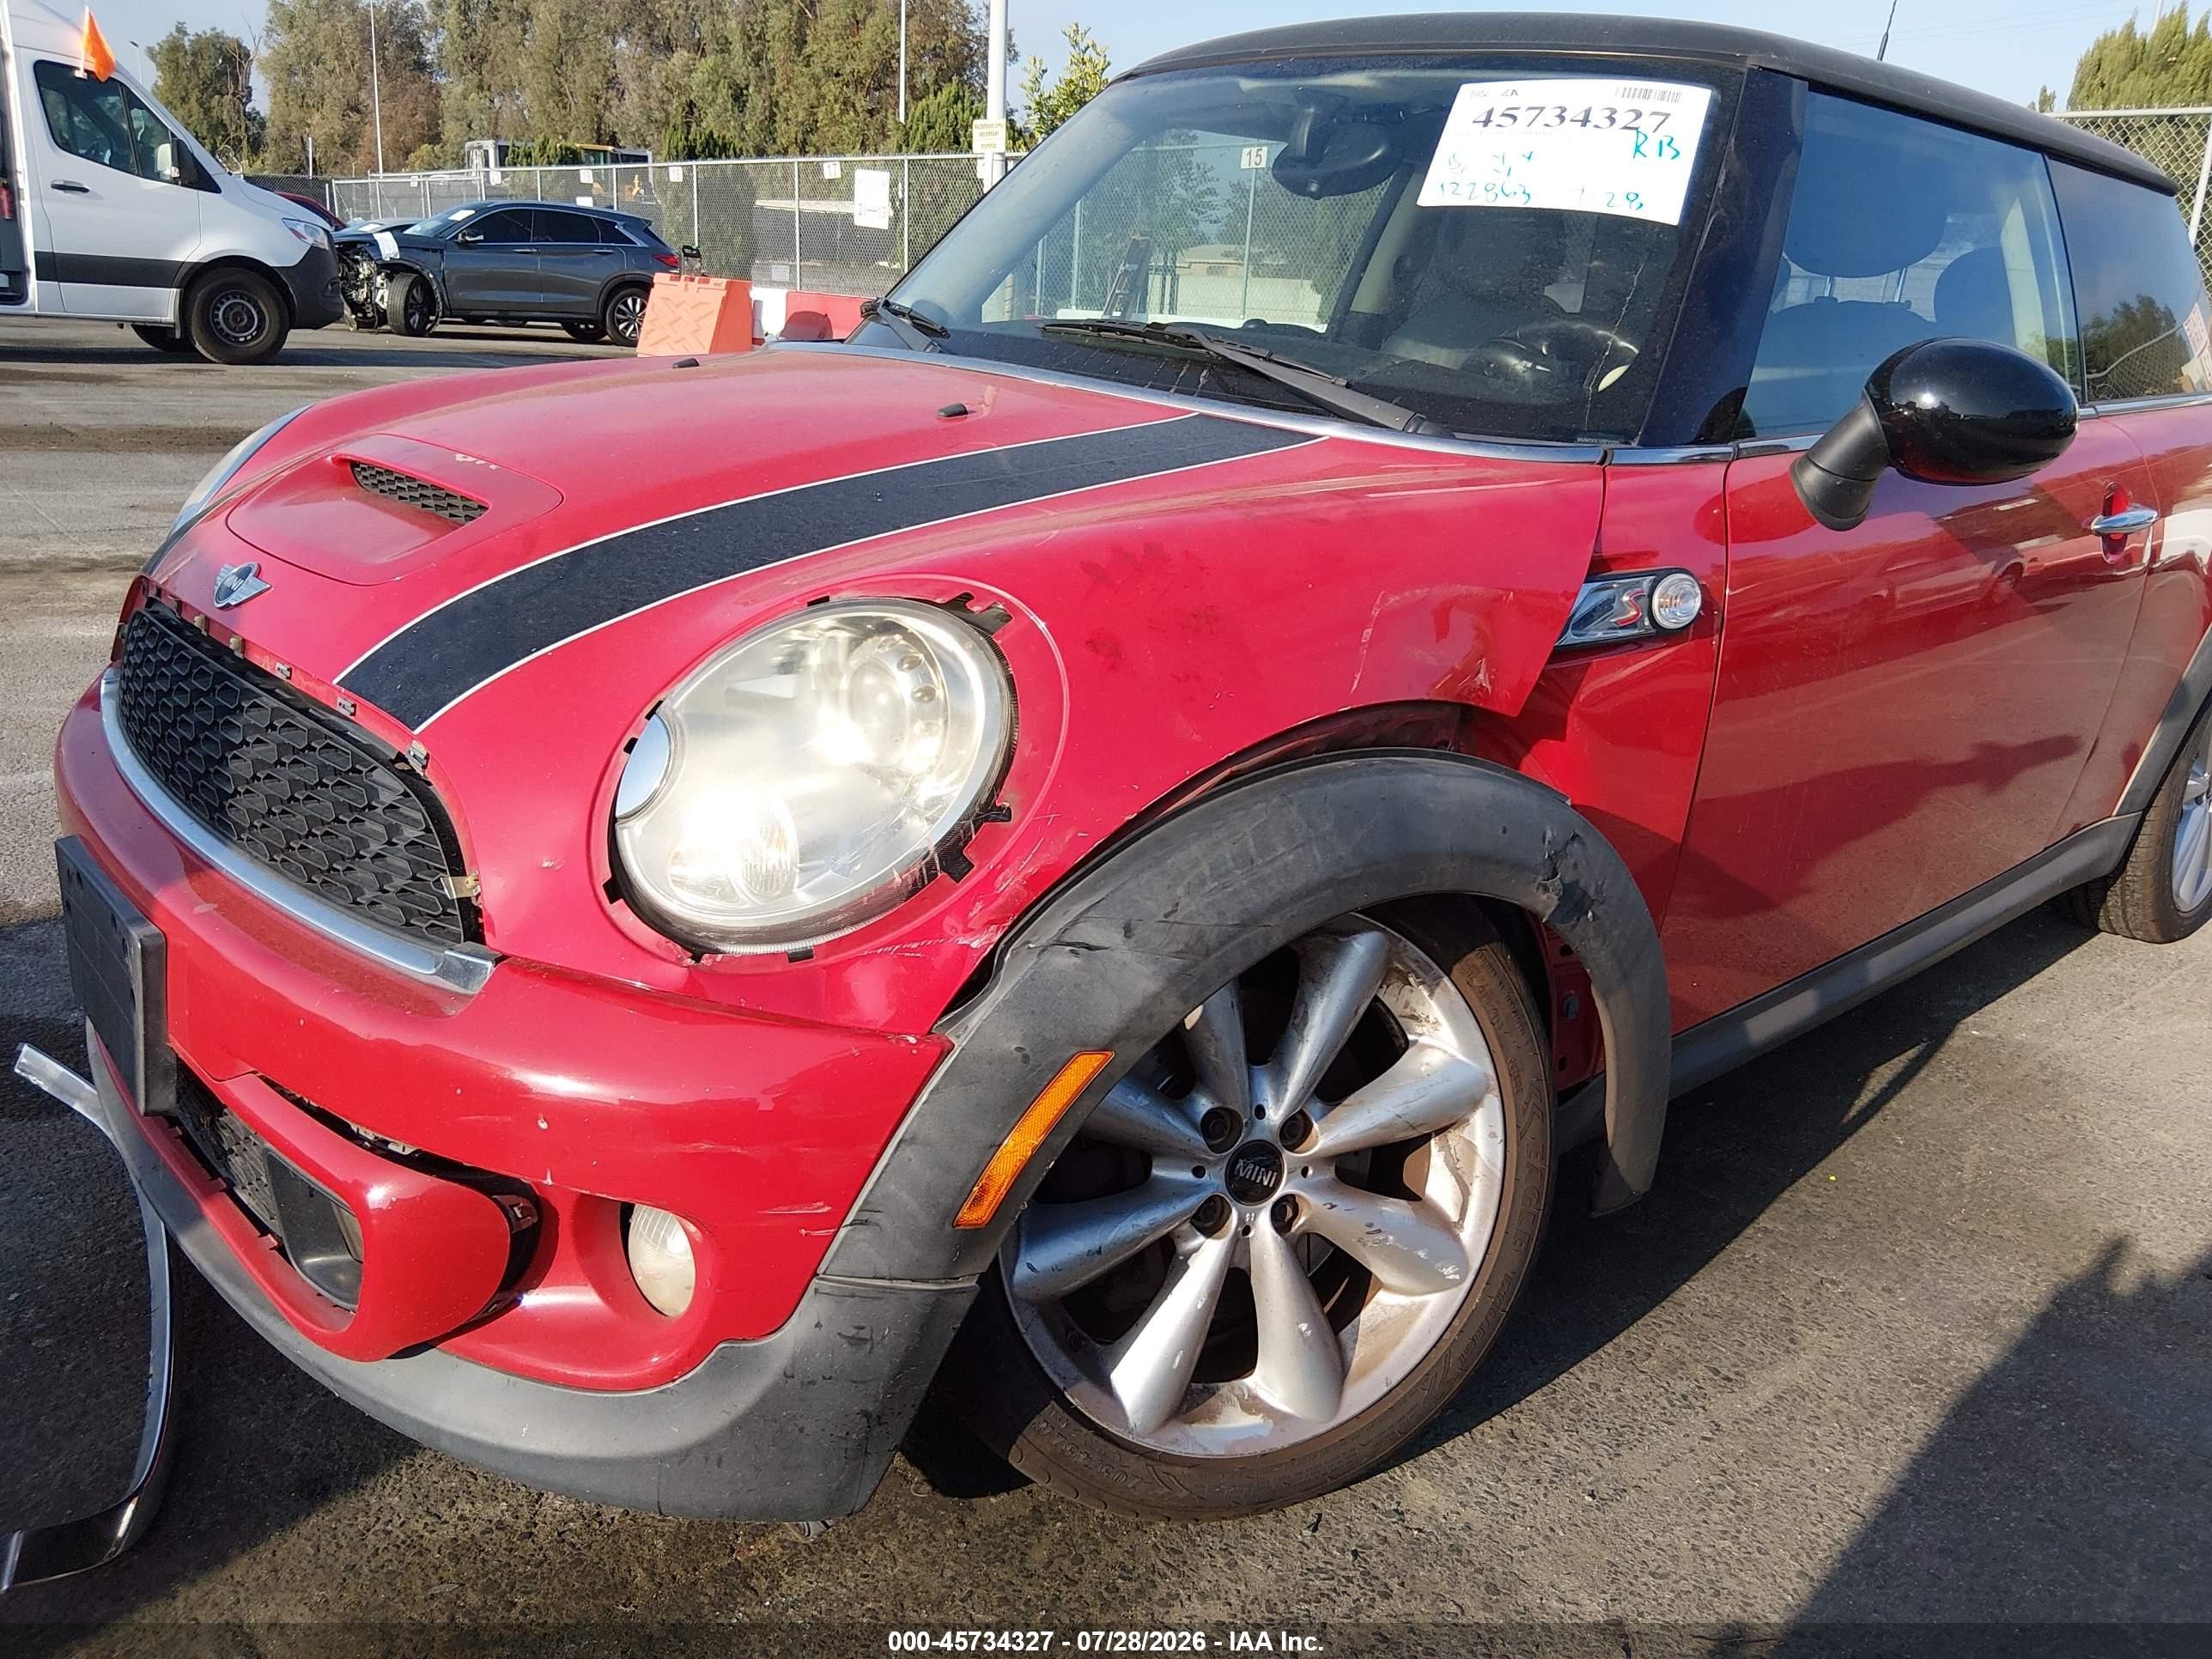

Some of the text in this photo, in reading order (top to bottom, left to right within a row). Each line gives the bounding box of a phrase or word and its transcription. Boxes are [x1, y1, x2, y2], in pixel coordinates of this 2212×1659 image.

[1472, 105, 1672, 134] 45734327
[1246, 148, 1263, 167] 15
[1608, 589, 1647, 628] S
[1234, 1159, 1278, 1188] MINI
[1511, 1143, 1545, 1249] EAGLE
